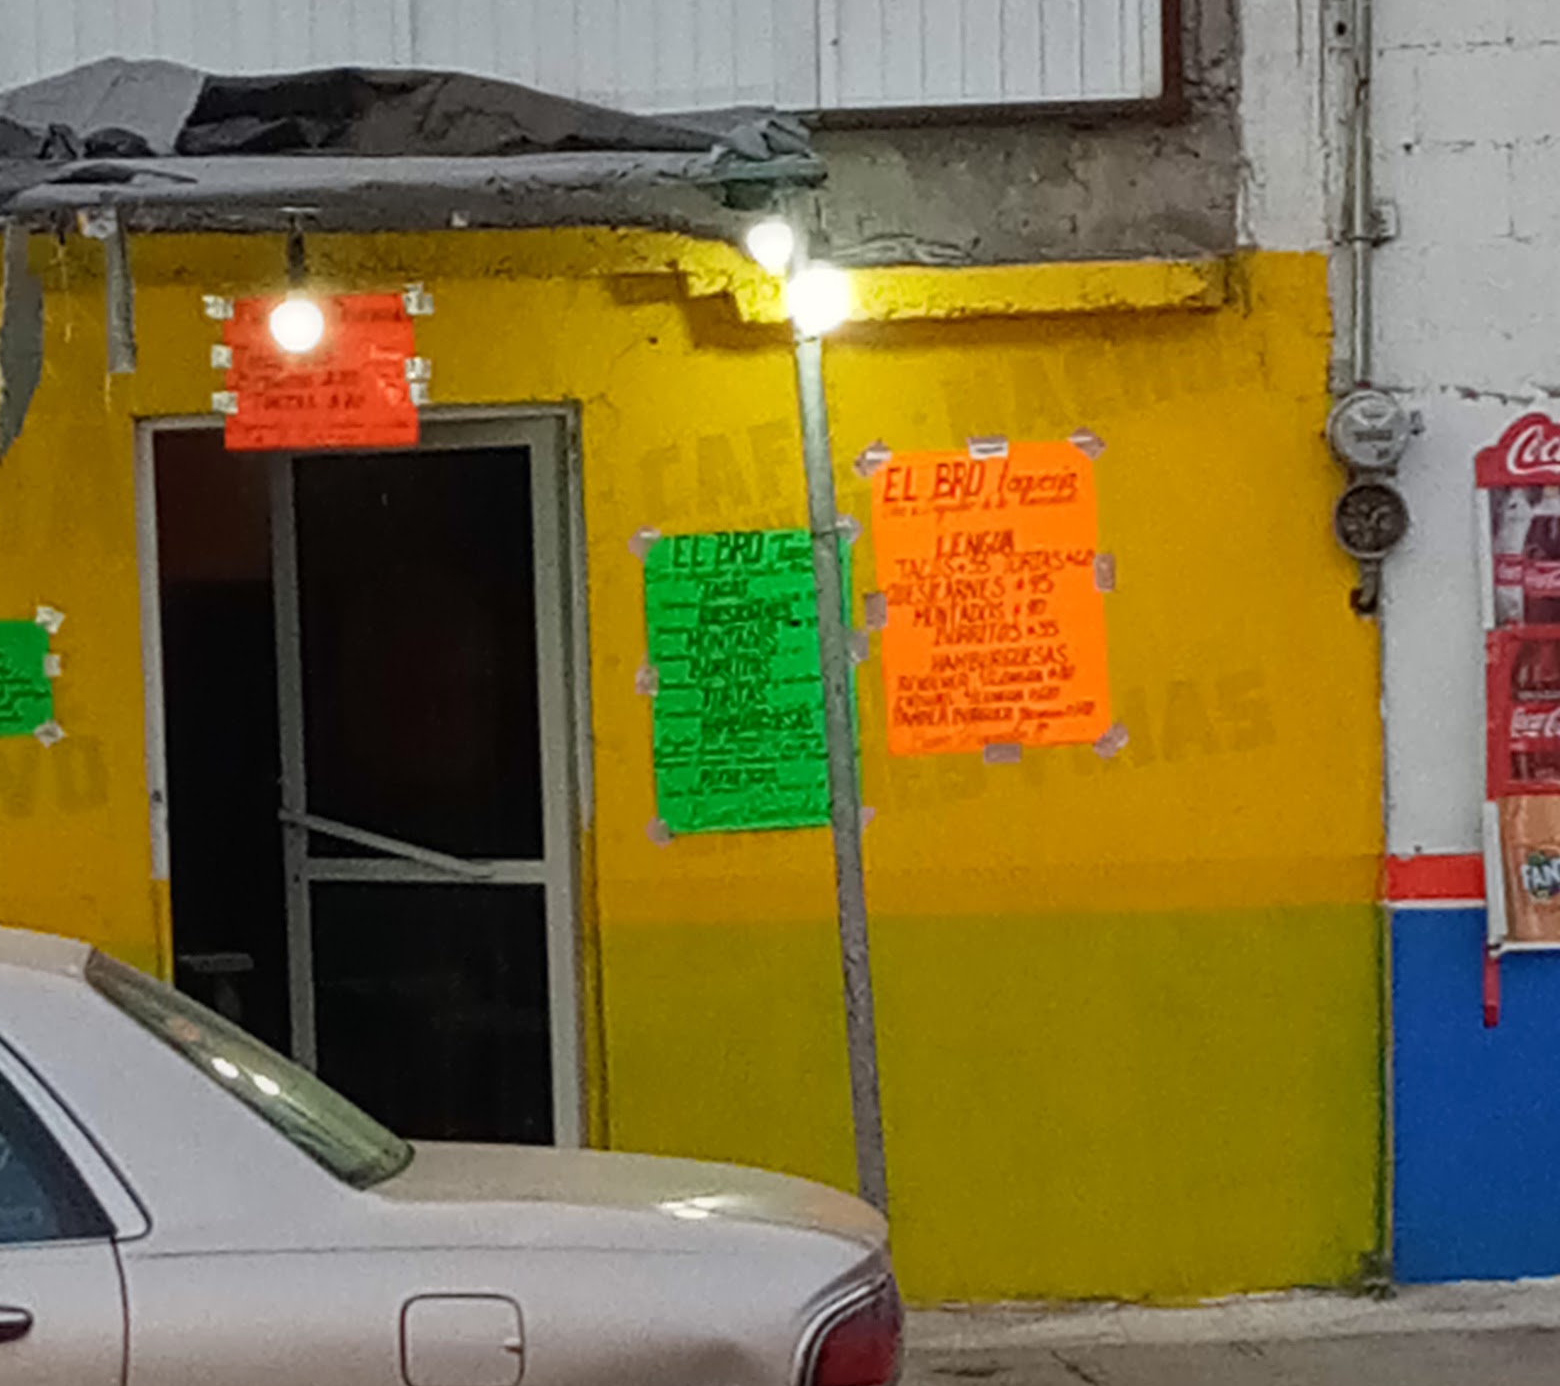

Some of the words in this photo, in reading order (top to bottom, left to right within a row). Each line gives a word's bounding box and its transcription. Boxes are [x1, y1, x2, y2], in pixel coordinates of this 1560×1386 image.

[883, 466, 918, 503] EL
[933, 461, 987, 499] BRO
[672, 535, 708, 568] EL
[713, 530, 764, 564] BRO
[936, 529, 1014, 559] LENGUA
